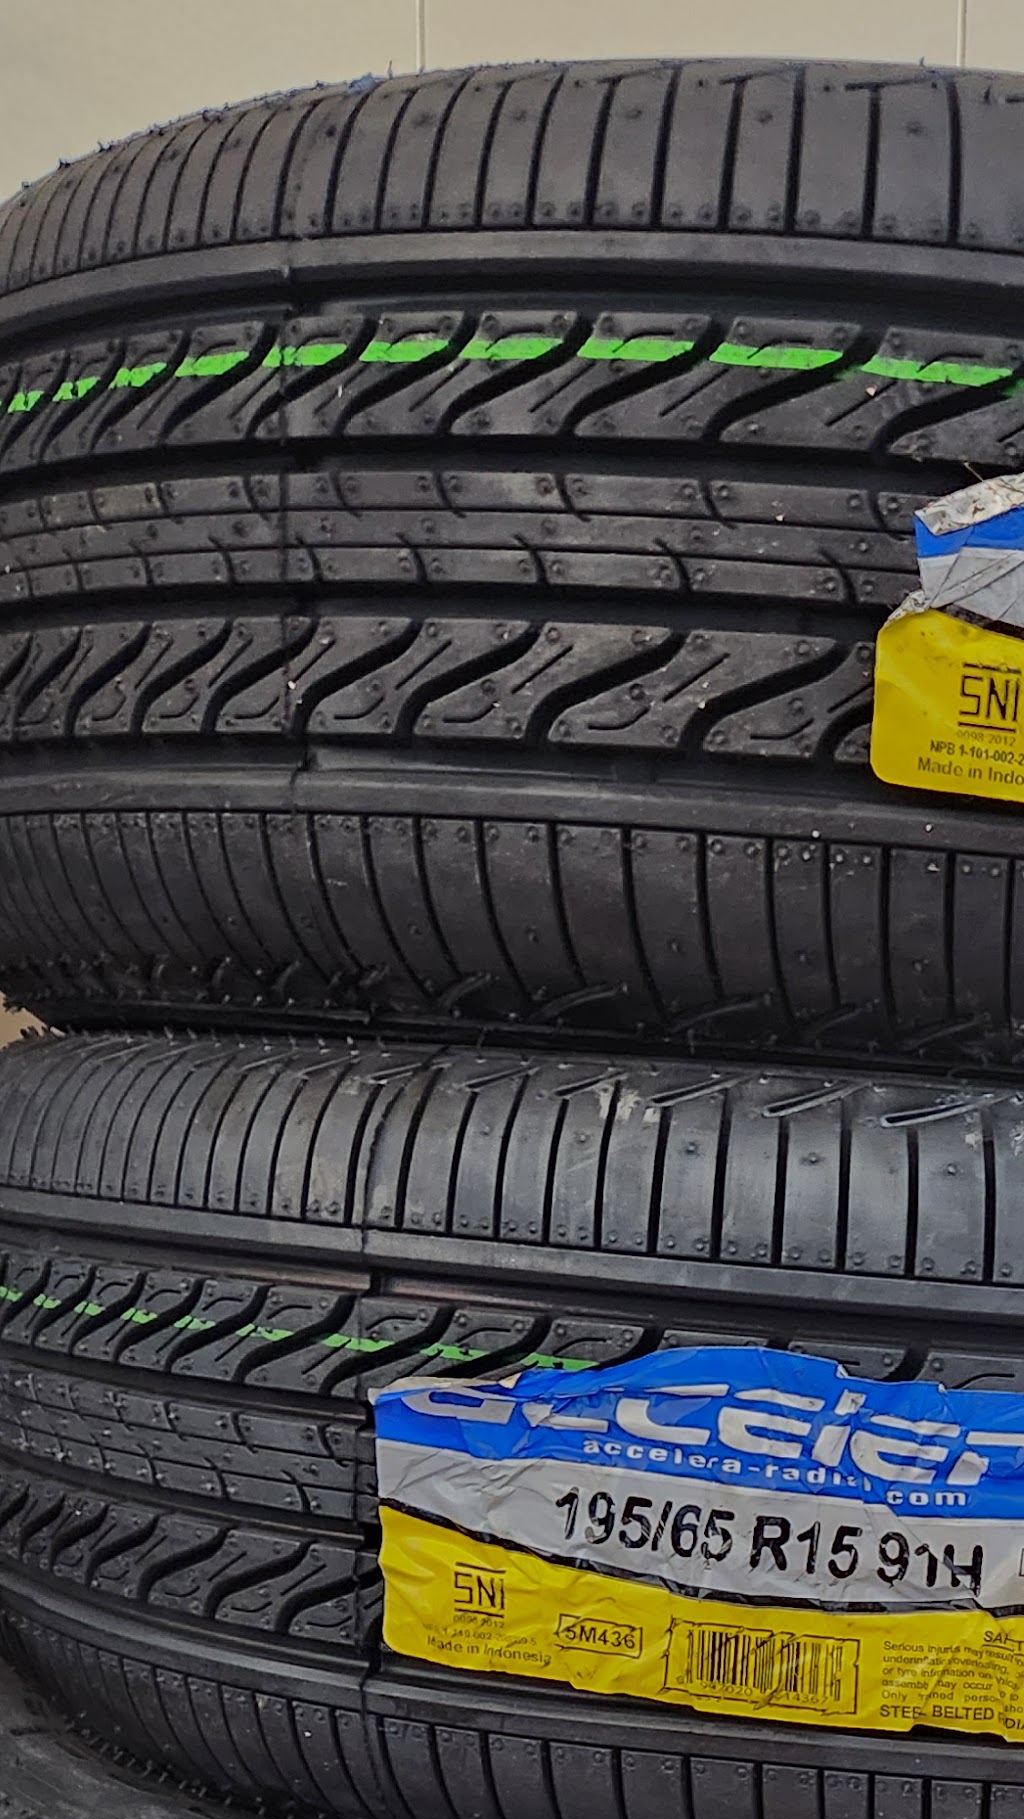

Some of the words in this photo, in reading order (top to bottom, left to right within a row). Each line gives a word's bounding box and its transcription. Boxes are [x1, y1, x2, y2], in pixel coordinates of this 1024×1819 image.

[959, 674, 1020, 722] SNI
[930, 739, 956, 755] NPB
[918, 756, 963, 776] Made
[968, 766, 983, 780] in
[555, 1487, 735, 1561] 195/65
[750, 1515, 862, 1578] R15
[876, 1532, 983, 1596] 91H
[454, 1571, 505, 1610] SNI
[566, 1625, 636, 1648] 5M436
[883, 1640, 924, 1653] Serious
[467, 1640, 480, 1654] in
[483, 1640, 552, 1665] Indonesia
[881, 1690, 907, 1701] Only
[963, 1682, 992, 1690] occur
[932, 1705, 994, 1721] BELTED
